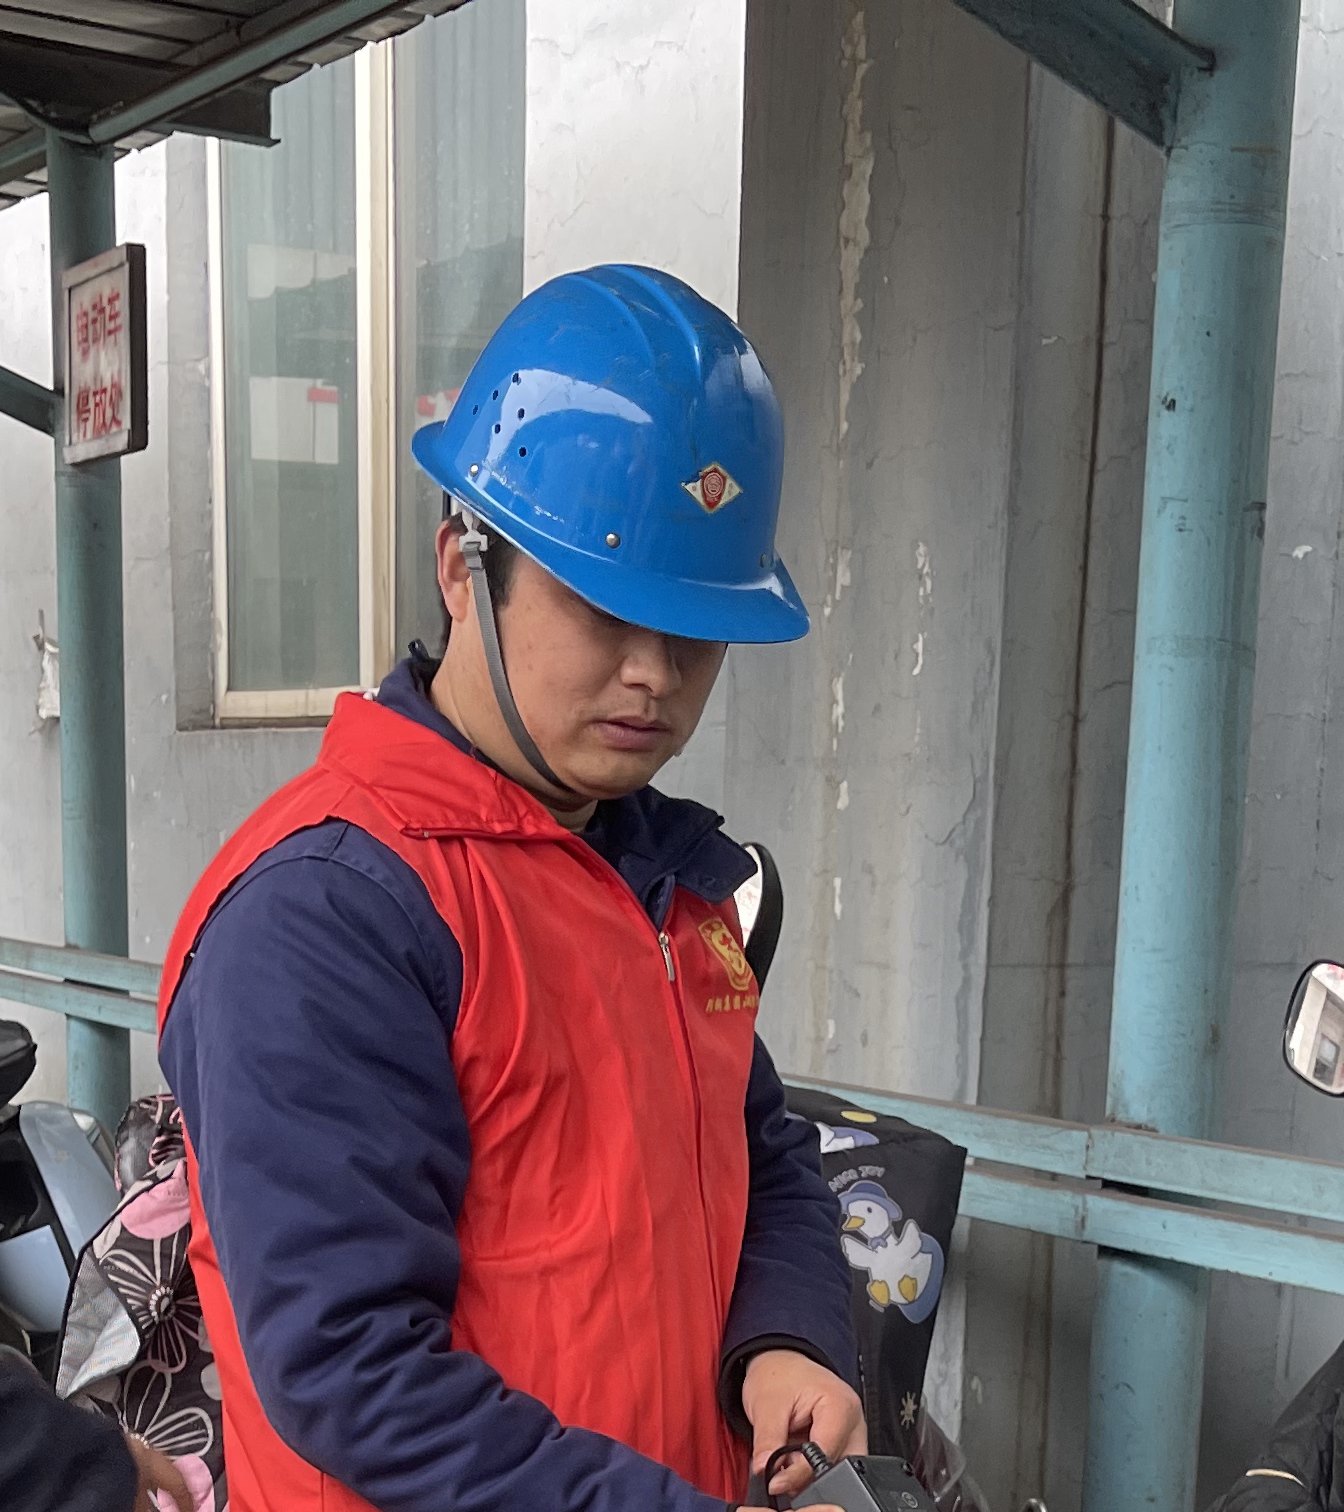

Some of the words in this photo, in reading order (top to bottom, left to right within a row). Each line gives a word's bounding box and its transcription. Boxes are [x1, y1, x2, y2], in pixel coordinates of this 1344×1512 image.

[76, 291, 122, 356] 电动车
[76, 385, 123, 439] 停放处
